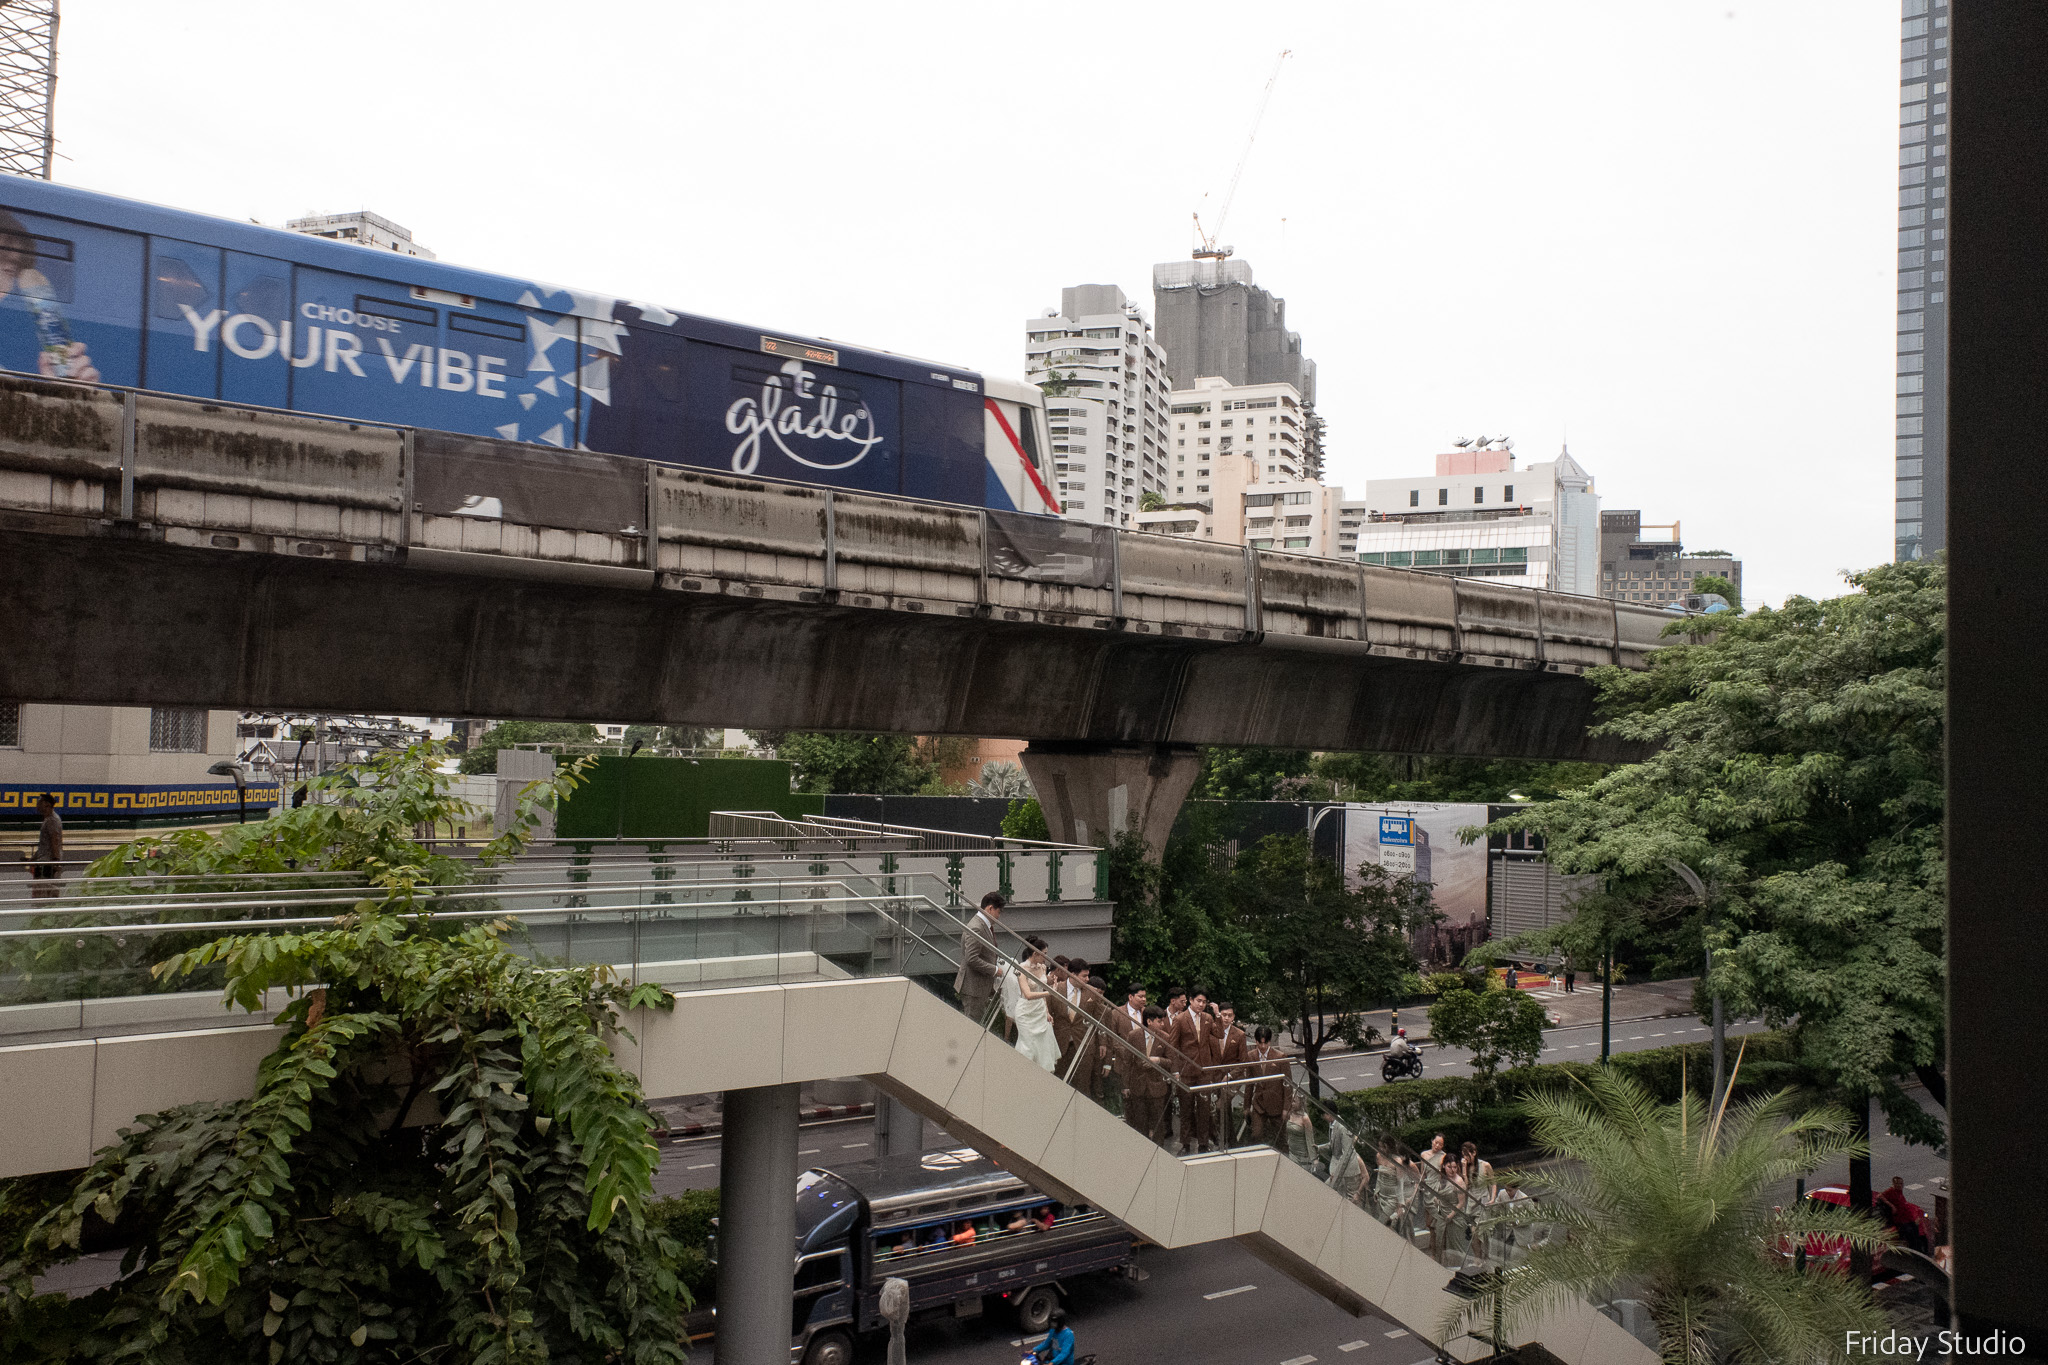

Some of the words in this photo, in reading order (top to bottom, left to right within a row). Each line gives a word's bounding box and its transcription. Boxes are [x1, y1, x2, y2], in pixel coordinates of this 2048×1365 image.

[300, 302, 402, 335] CHOOSE
[177, 303, 369, 378] YOUR
[375, 336, 508, 399] VIBE
